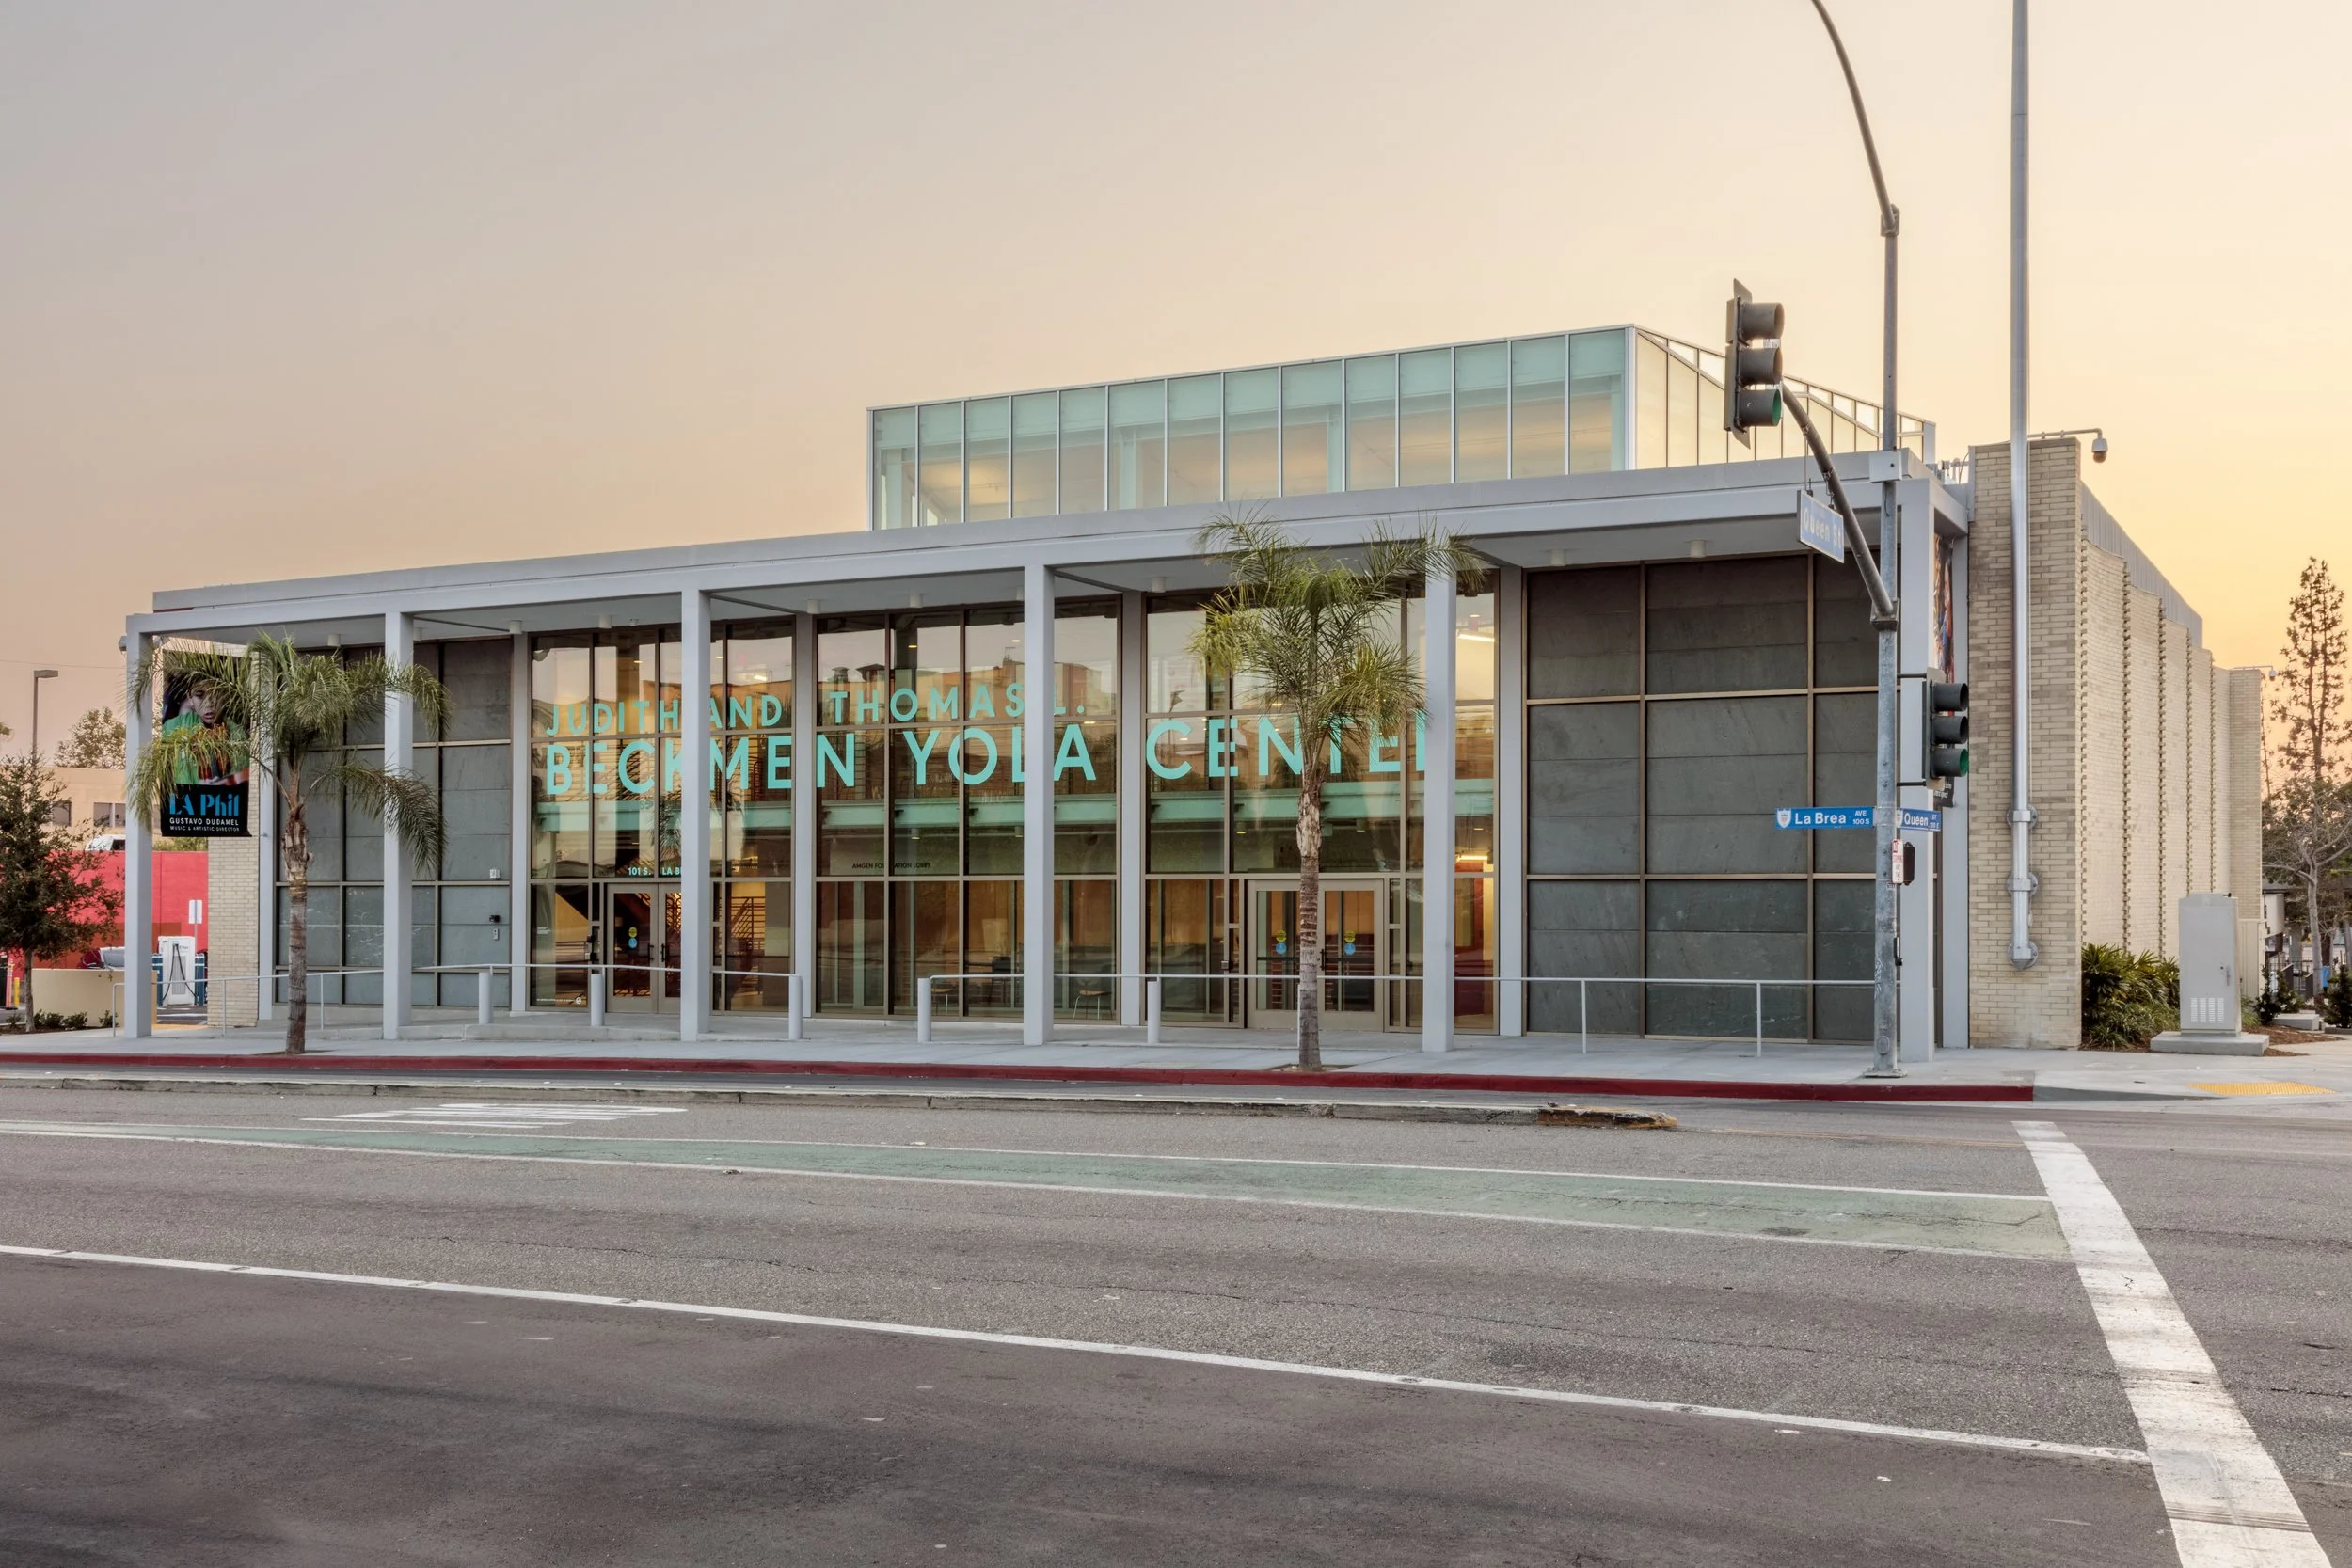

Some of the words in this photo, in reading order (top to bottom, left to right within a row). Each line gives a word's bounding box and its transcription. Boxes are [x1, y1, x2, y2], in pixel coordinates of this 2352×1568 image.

[1804, 508, 1830, 543] Queen
[546, 700, 679, 736] JUDITH
[830, 683, 1025, 723] THOMAS
[902, 723, 1097, 785] YOLA
[169, 793, 195, 816] LA
[200, 793, 240, 816] Phil
[1795, 813, 1811, 825] La
[1815, 812, 1847, 824] Brea
[1904, 812, 1929, 827] Queen
[628, 866, 642, 876] 101
[643, 866, 652, 876] S.
[661, 866, 674, 876] LA
